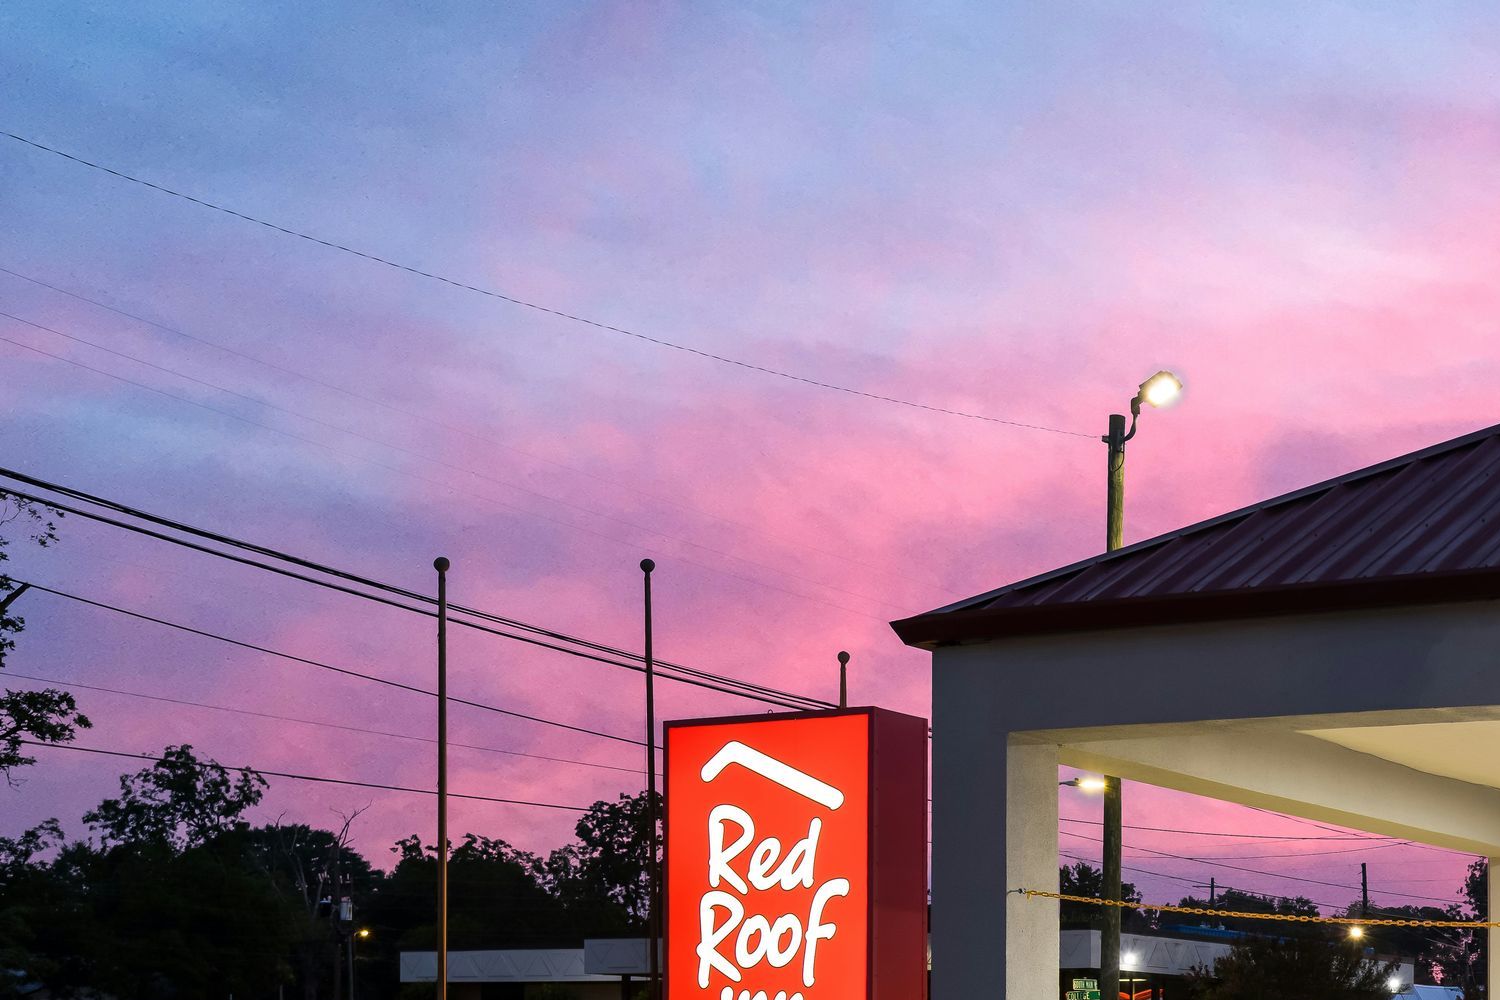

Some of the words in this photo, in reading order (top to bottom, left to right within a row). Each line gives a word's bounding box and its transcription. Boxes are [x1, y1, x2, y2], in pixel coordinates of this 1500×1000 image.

[708, 803, 823, 895] Red
[696, 877, 851, 989] Roof
[1068, 992, 1090, 1000] COLLEGE
